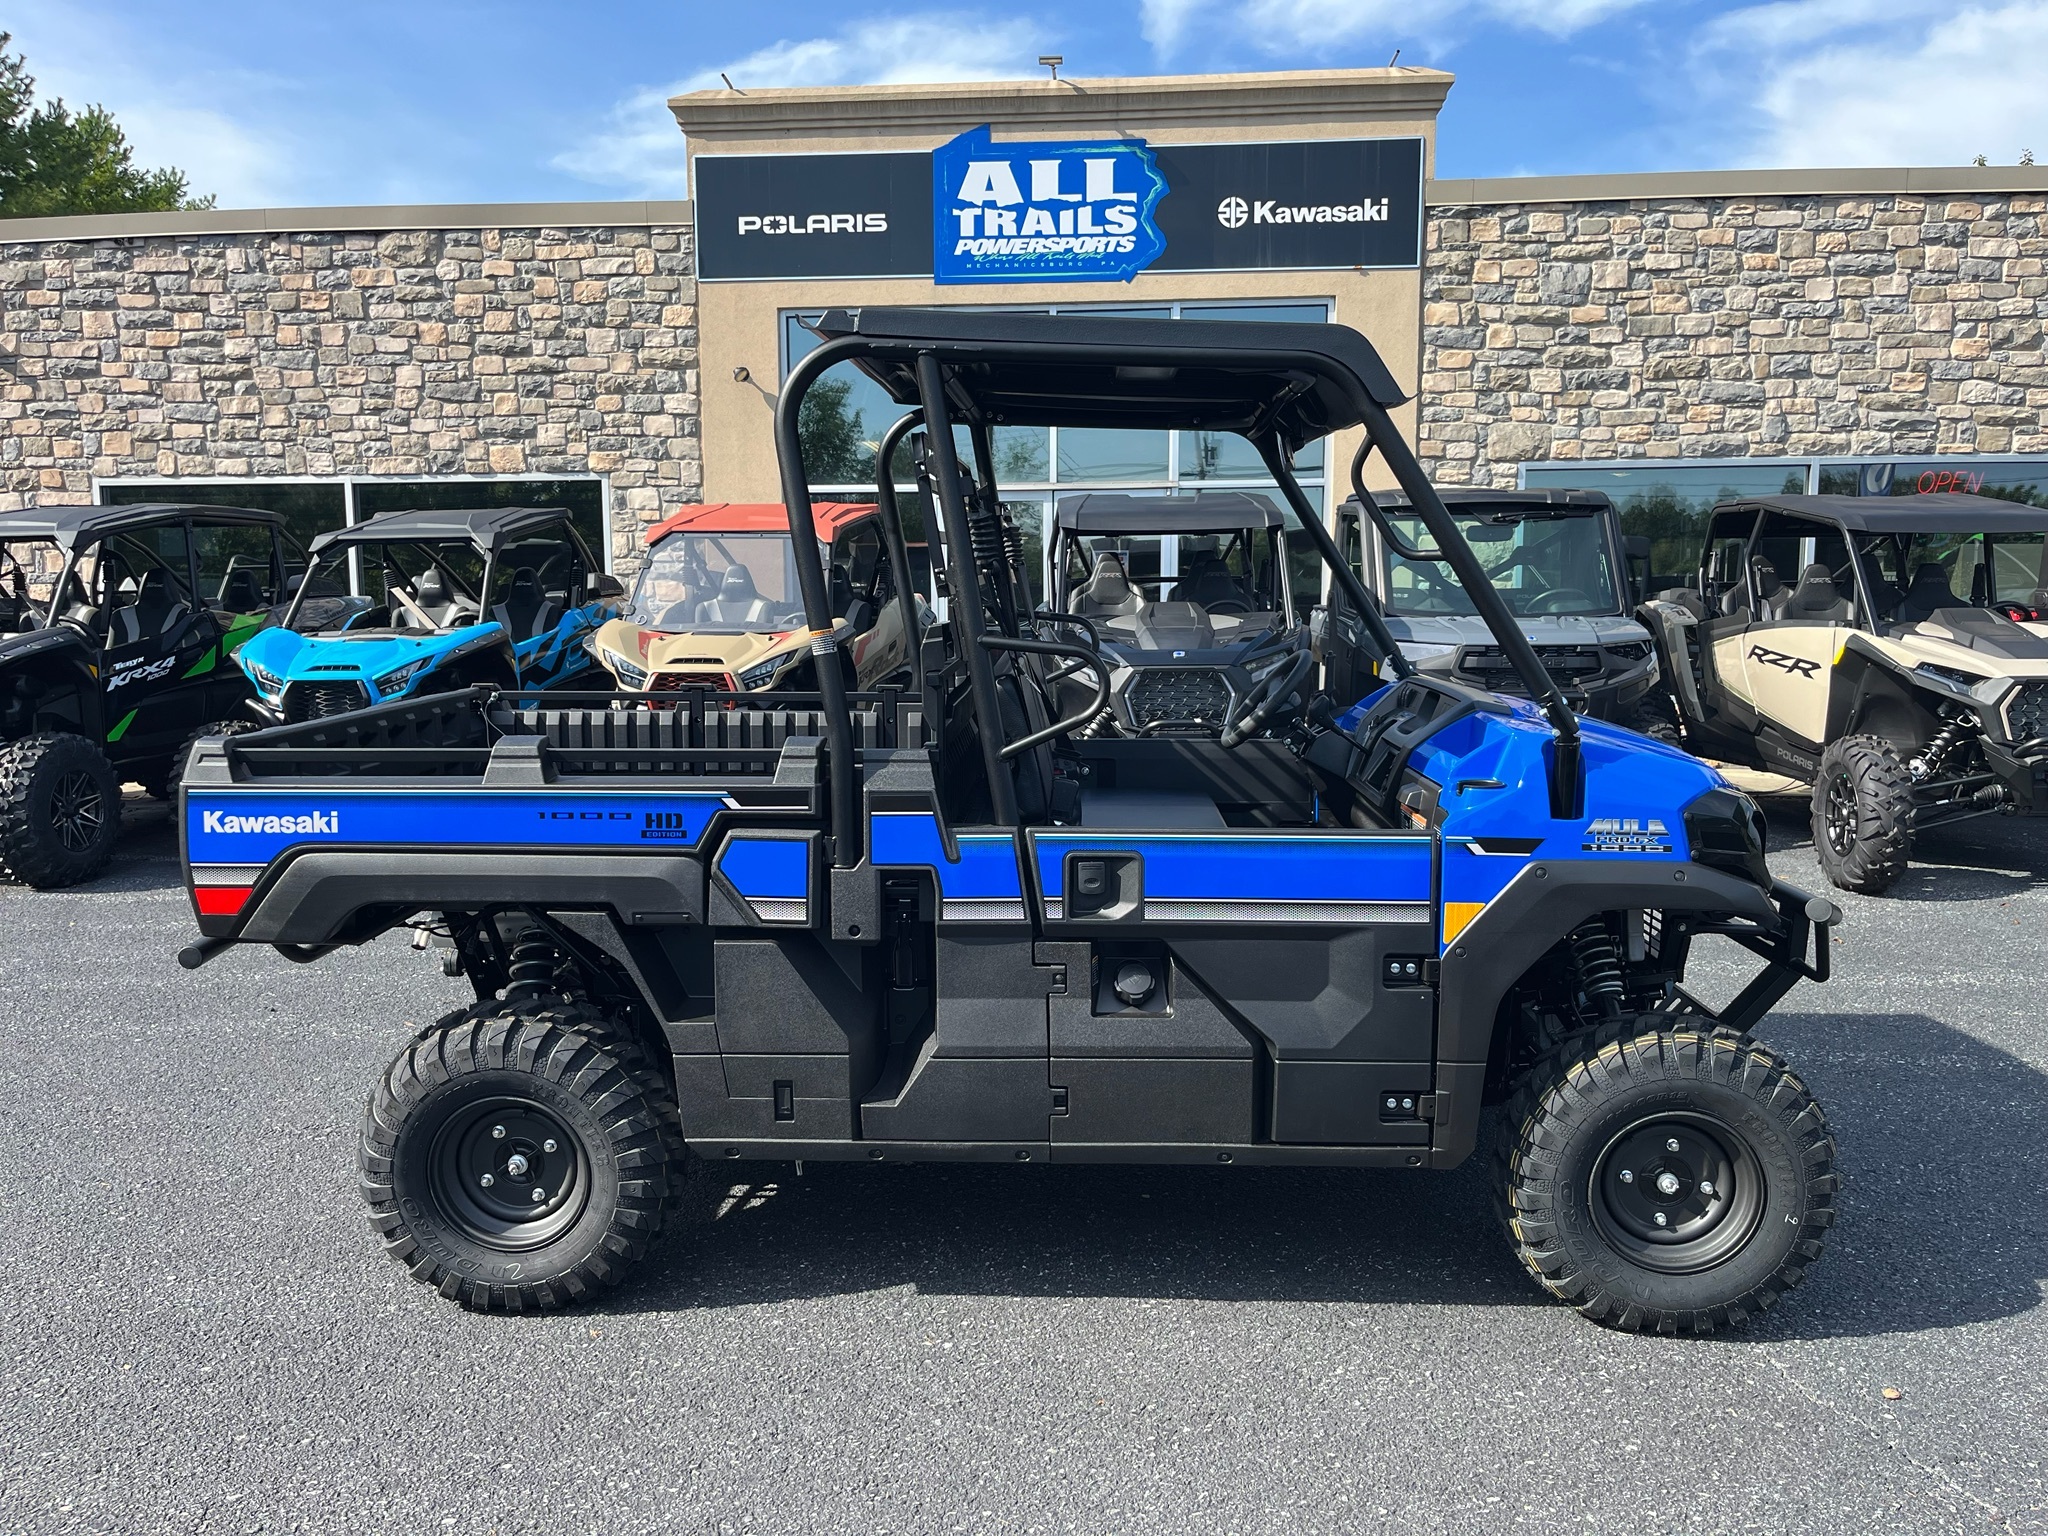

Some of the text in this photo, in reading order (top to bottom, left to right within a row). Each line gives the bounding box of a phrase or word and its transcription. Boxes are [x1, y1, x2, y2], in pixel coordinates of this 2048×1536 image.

[957, 158, 1138, 208] ALL
[952, 205, 1138, 237] TRAILS
[1253, 197, 1389, 224] Kawasaki
[738, 213, 888, 236] POLARIS
[954, 235, 1136, 256] POWERSPORTS
[1917, 470, 1985, 495] OPEN
[1747, 644, 1822, 680] RZR
[146, 668, 171, 682] 1000
[1776, 747, 1814, 771] POLARIS
[203, 810, 339, 834] Kawasaki
[537, 811, 632, 820] 1000
[645, 812, 683, 829] HD
[1584, 818, 1670, 836] MULE
[646, 830, 683, 838] EDITION
[1590, 844, 1665, 852] 1000
[401, 1197, 482, 1275] DURO
[1559, 1180, 1621, 1282] DURO
[505, 1262, 525, 1281] 2
